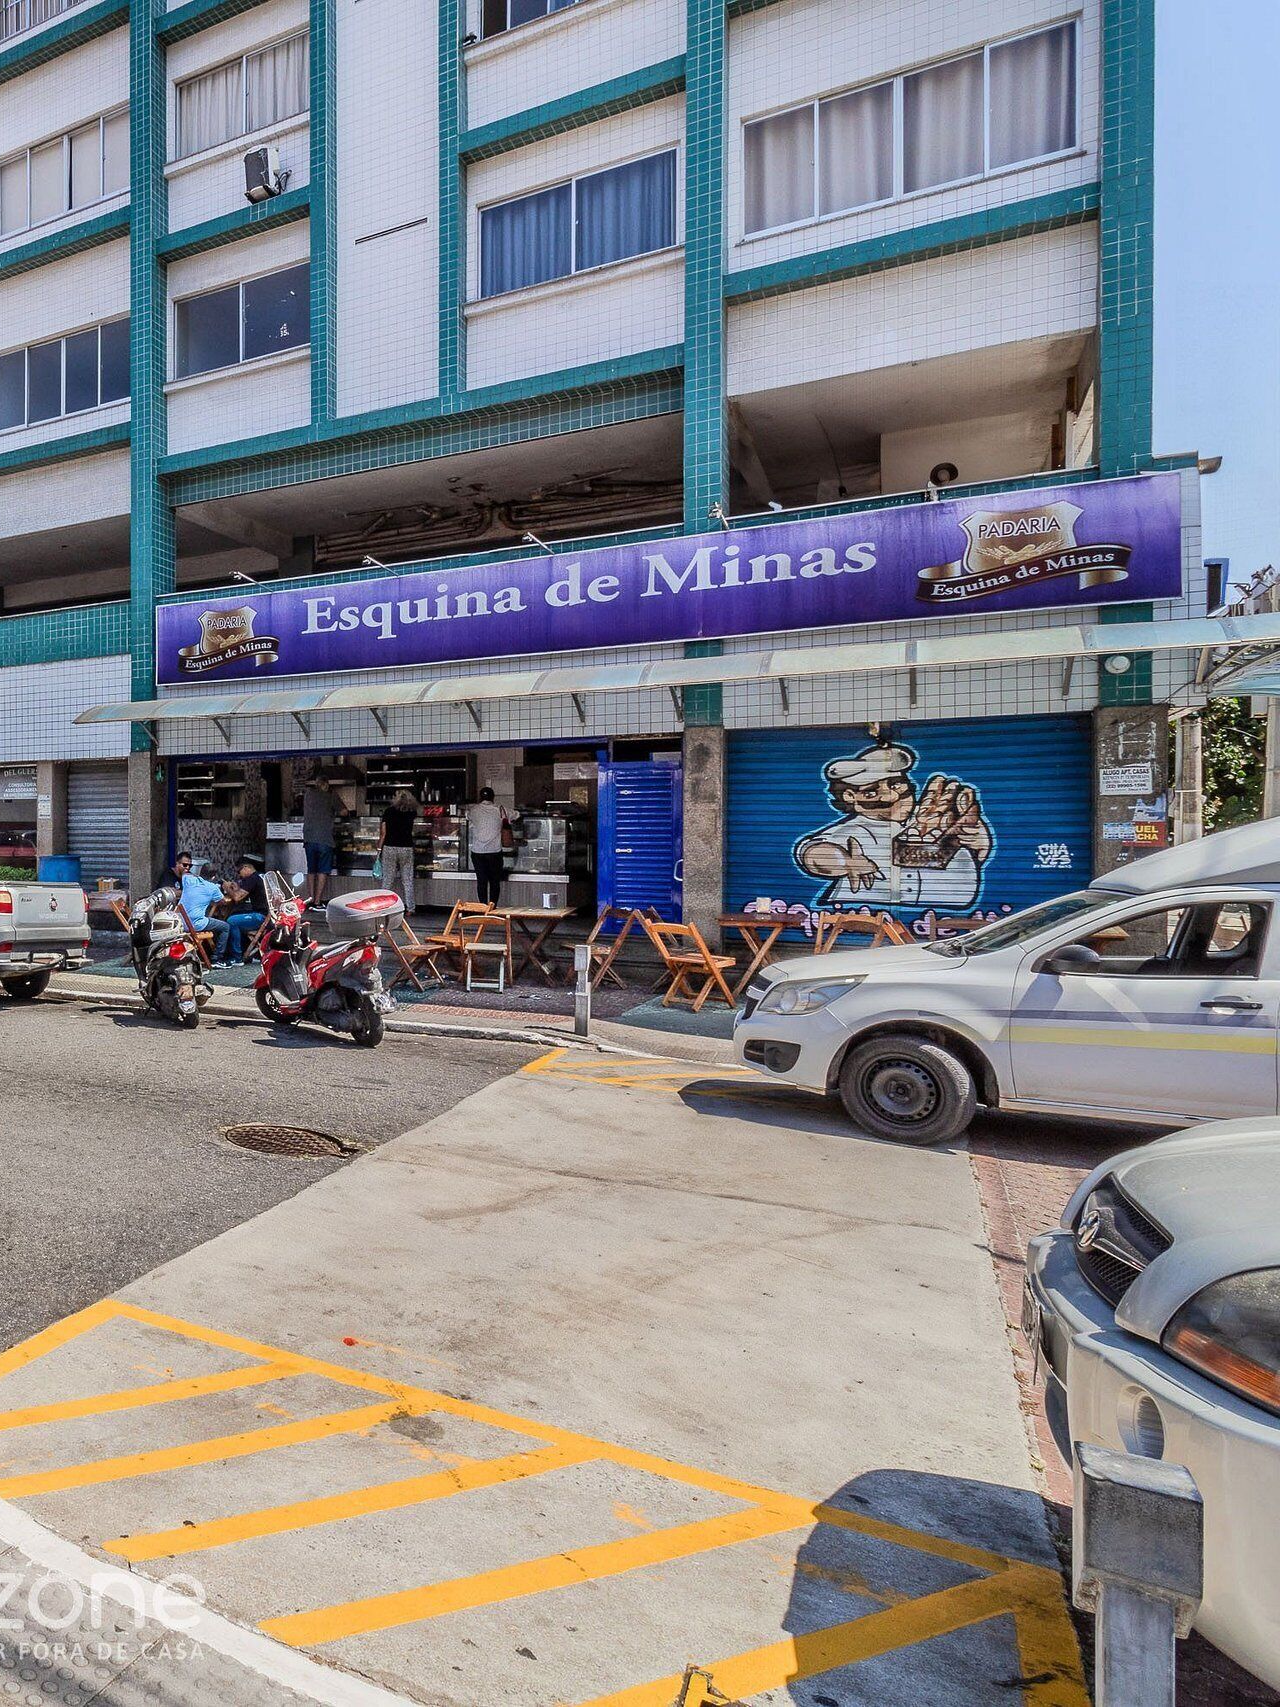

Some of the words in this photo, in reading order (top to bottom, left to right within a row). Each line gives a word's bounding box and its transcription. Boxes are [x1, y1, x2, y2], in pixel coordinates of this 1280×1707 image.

[978, 516, 1061, 539] PADARIA
[931, 576, 1011, 598] Esquina
[1015, 562, 1040, 580] de
[1044, 552, 1115, 572] Minas
[301, 583, 527, 640] Esquina
[544, 561, 621, 607] de
[640, 542, 877, 597] Minas
[207, 615, 247, 630] PADARIA
[185, 655, 223, 669] Esquina
[225, 648, 237, 658] de
[239, 641, 272, 654] Minas
